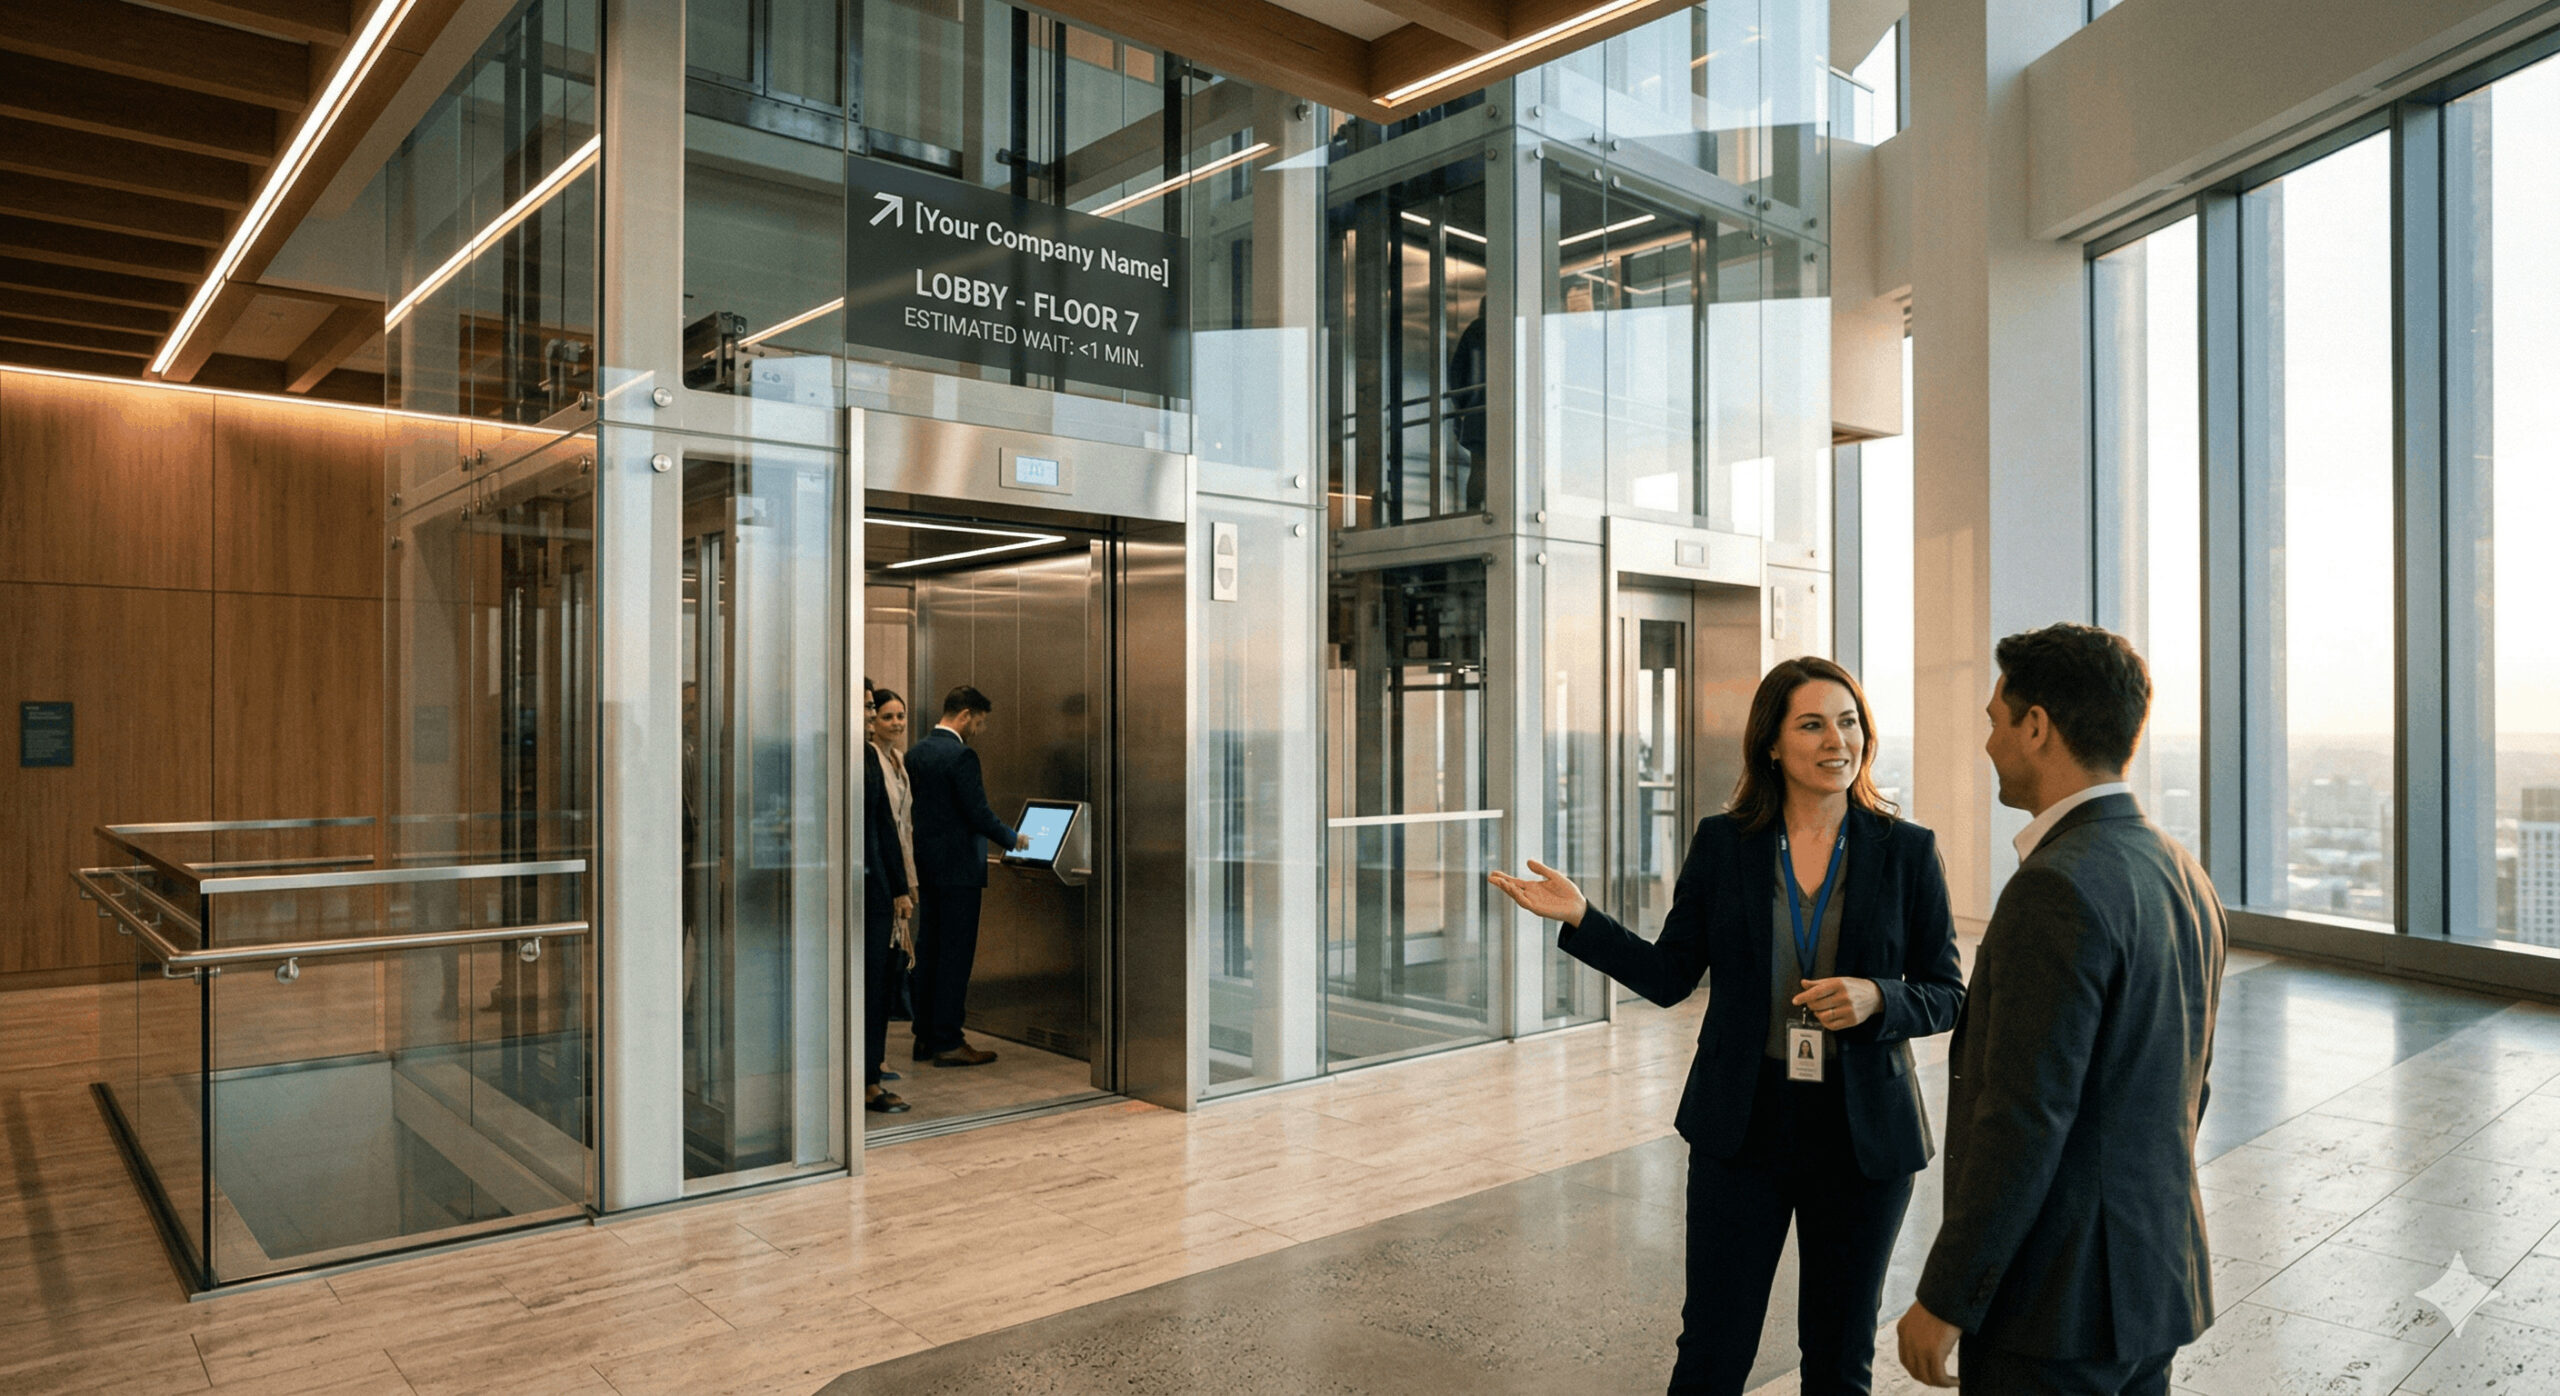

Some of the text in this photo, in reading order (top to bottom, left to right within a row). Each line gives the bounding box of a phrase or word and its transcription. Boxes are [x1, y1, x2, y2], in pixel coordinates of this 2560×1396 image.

[915, 201, 1169, 288] [Your Company Name]
[916, 269, 1008, 310] LOBBY
[1034, 292, 1117, 332] FLOOR
[1124, 311, 1139, 336] 7
[904, 306, 1144, 368] ESTIMATED WAIT: <1 MIN.
